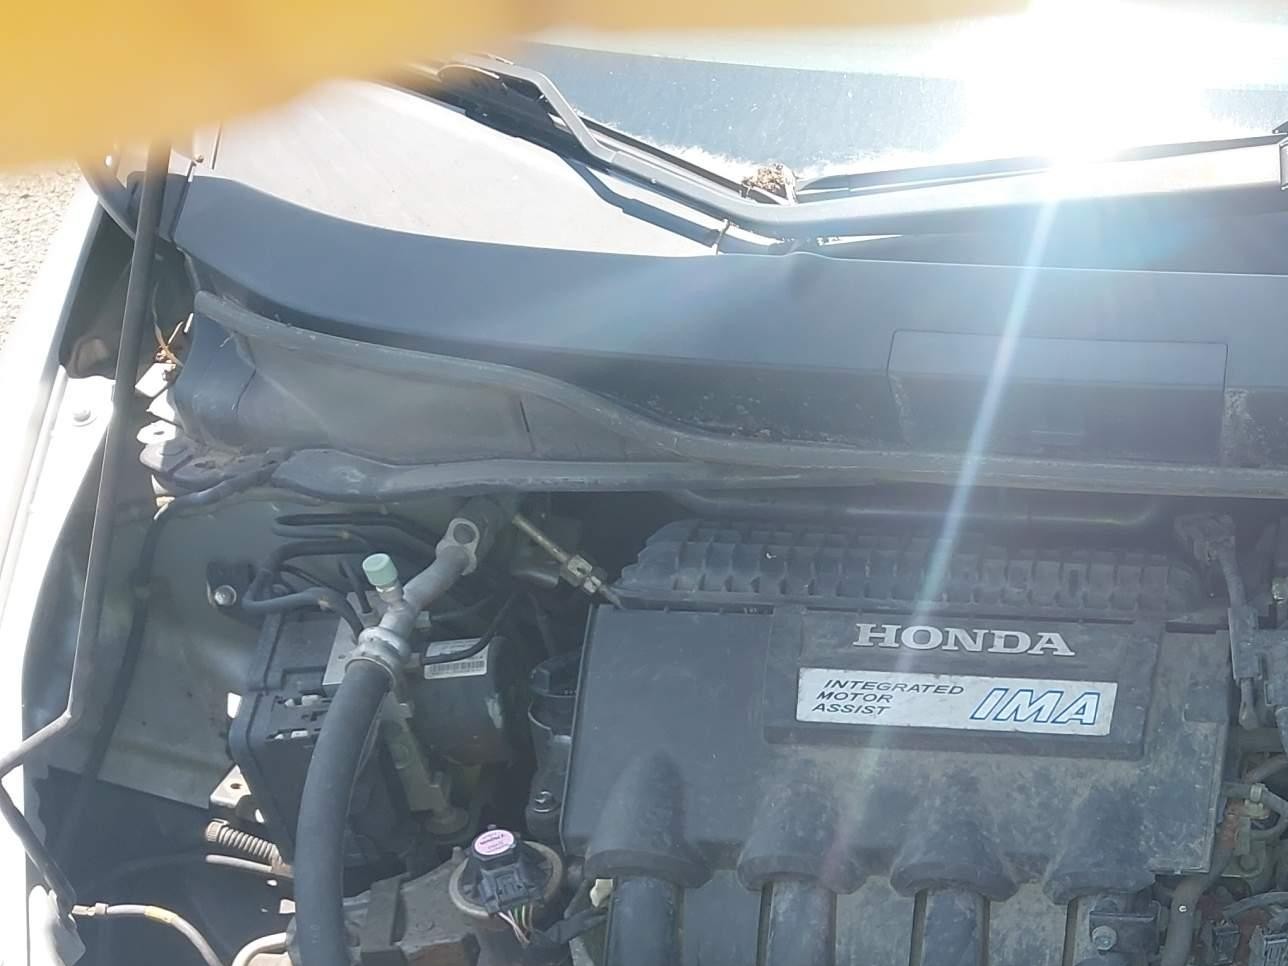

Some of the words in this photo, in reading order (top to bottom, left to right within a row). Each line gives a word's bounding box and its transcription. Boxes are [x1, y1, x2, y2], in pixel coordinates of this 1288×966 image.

[853, 623, 1075, 656] HONDA
[823, 679, 965, 695] INTEGRATED
[817, 691, 894, 704] MOTOR
[812, 703, 891, 716] ASSIST
[970, 688, 1100, 726] IMA
